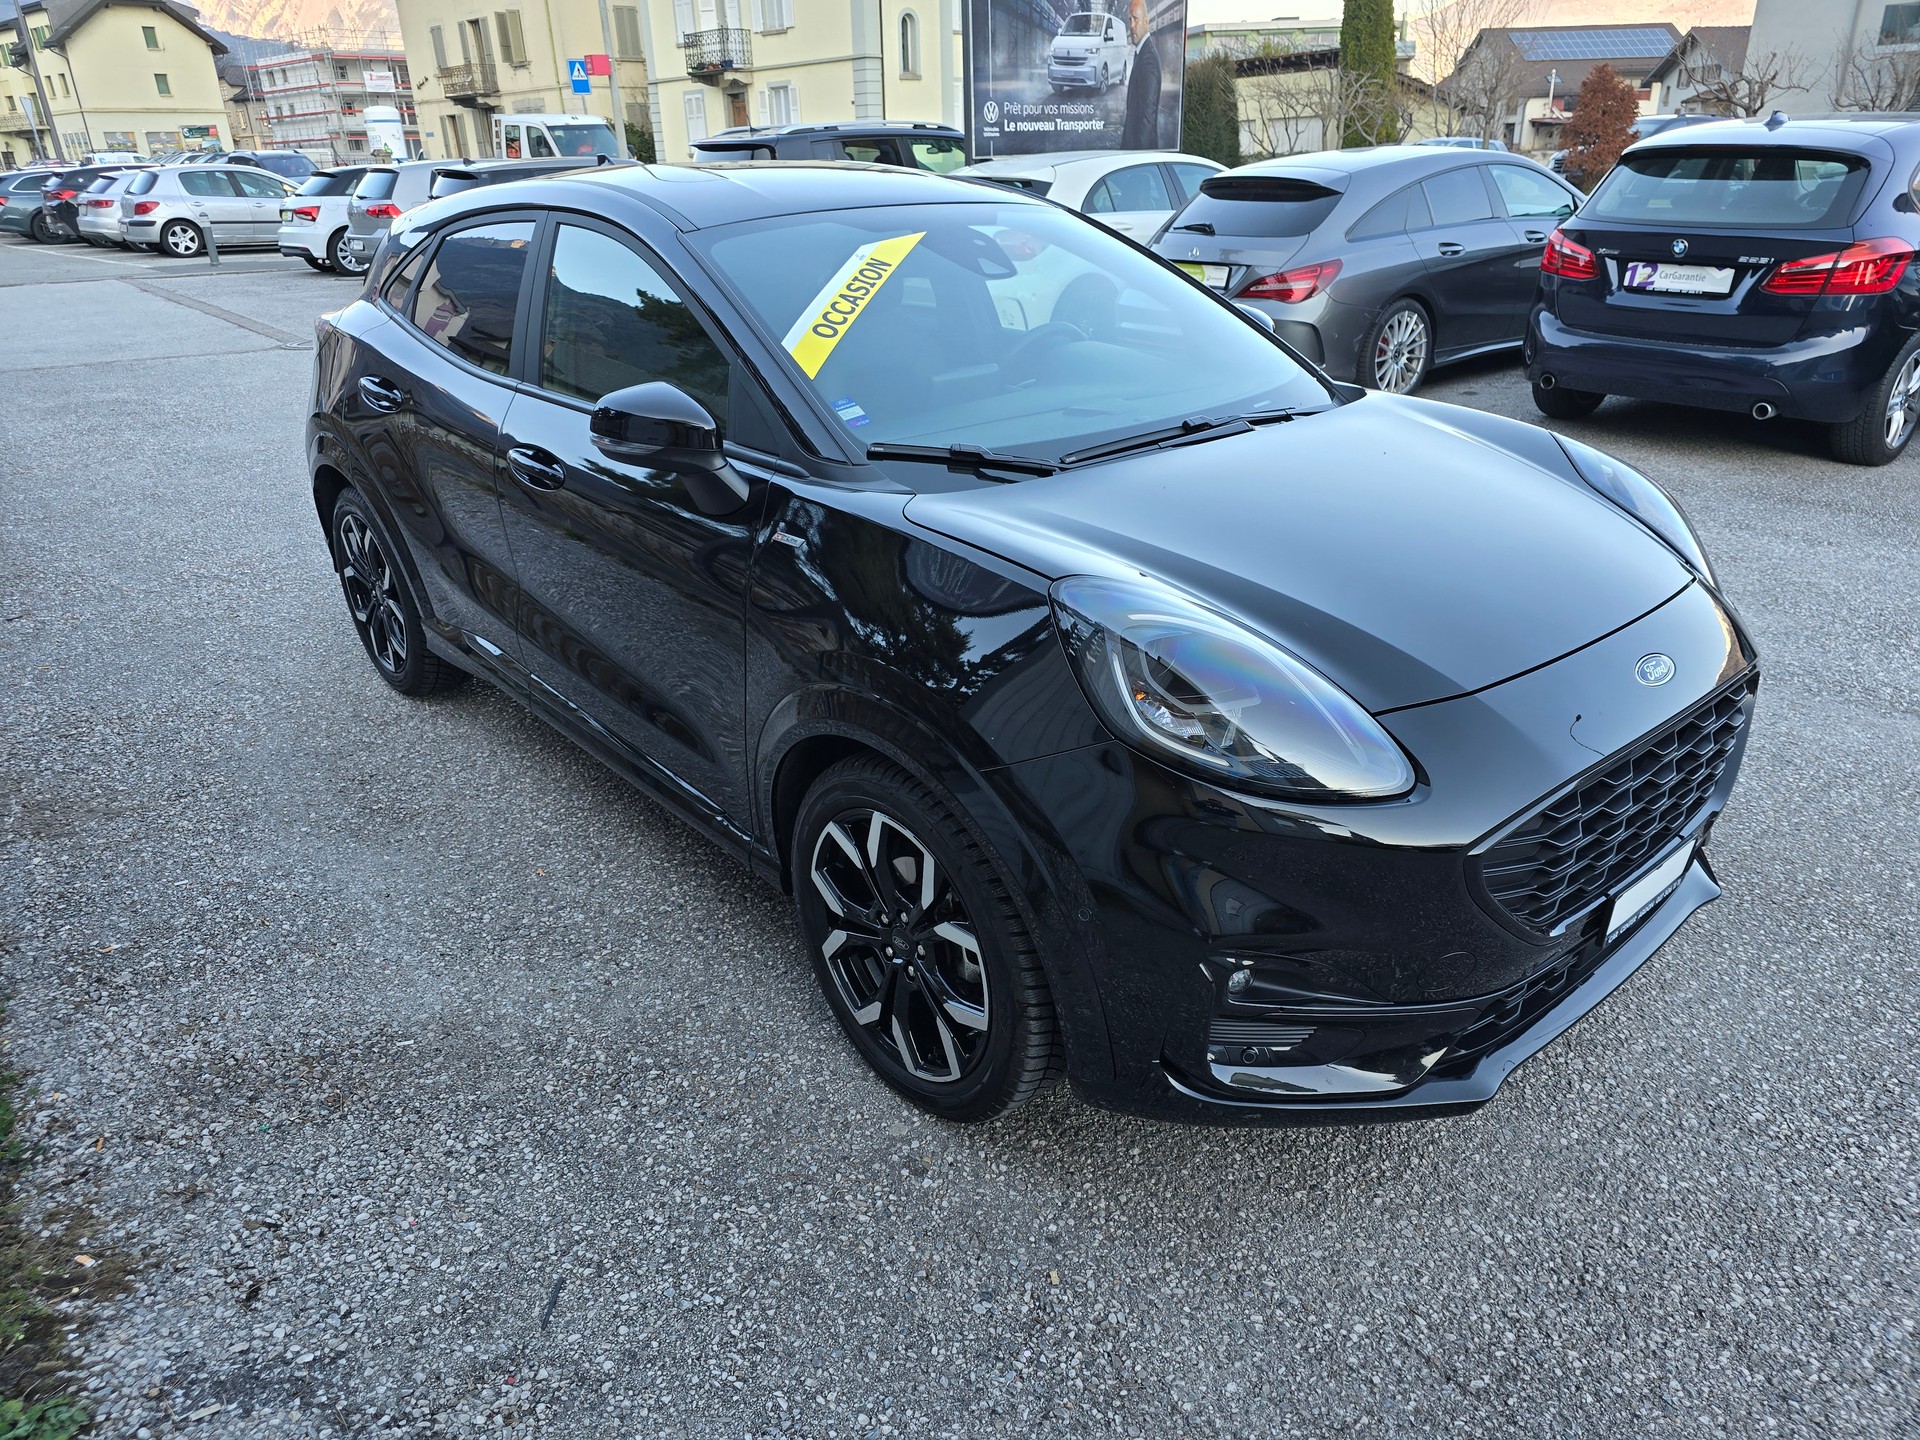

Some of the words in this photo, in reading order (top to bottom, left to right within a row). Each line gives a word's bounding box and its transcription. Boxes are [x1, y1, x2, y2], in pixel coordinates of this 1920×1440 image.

[1003, 102, 1022, 114] Prêt
[1023, 104, 1043, 117] pour
[1044, 105, 1059, 115] vos
[1060, 102, 1094, 115] missions
[1004, 119, 1016, 132] Le
[1017, 121, 1055, 132] nouveau
[1056, 118, 1105, 133] Transporter
[1625, 262, 1659, 288] 12
[1659, 270, 1707, 283] CarGarantie
[812, 257, 893, 339] OCCASION
[1643, 660, 1668, 681] Ford
